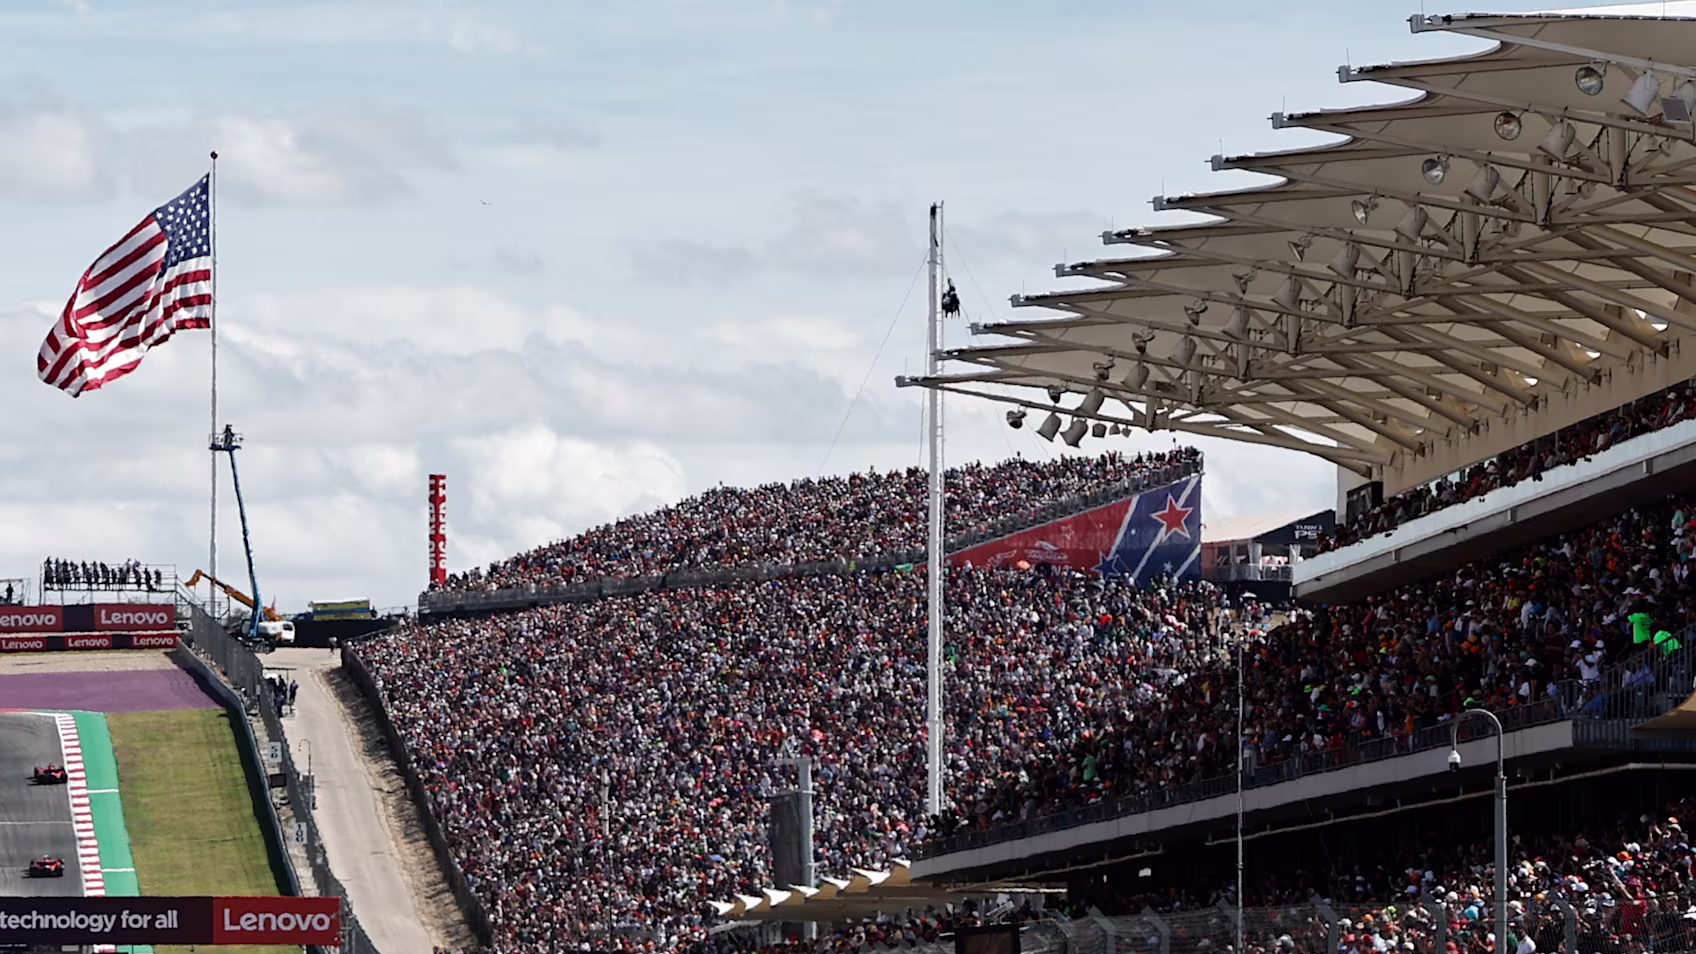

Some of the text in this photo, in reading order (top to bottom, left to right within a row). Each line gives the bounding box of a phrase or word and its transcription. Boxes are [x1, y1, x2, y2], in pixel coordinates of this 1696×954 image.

[101, 609, 167, 625] Lenovo
[2, 639, 43, 649] Lenovo
[68, 637, 109, 647] Lenovo
[133, 635, 173, 646] Lenovo
[121, 908, 153, 930] for
[155, 908, 178, 930] all
[223, 908, 331, 932] Lenovo
